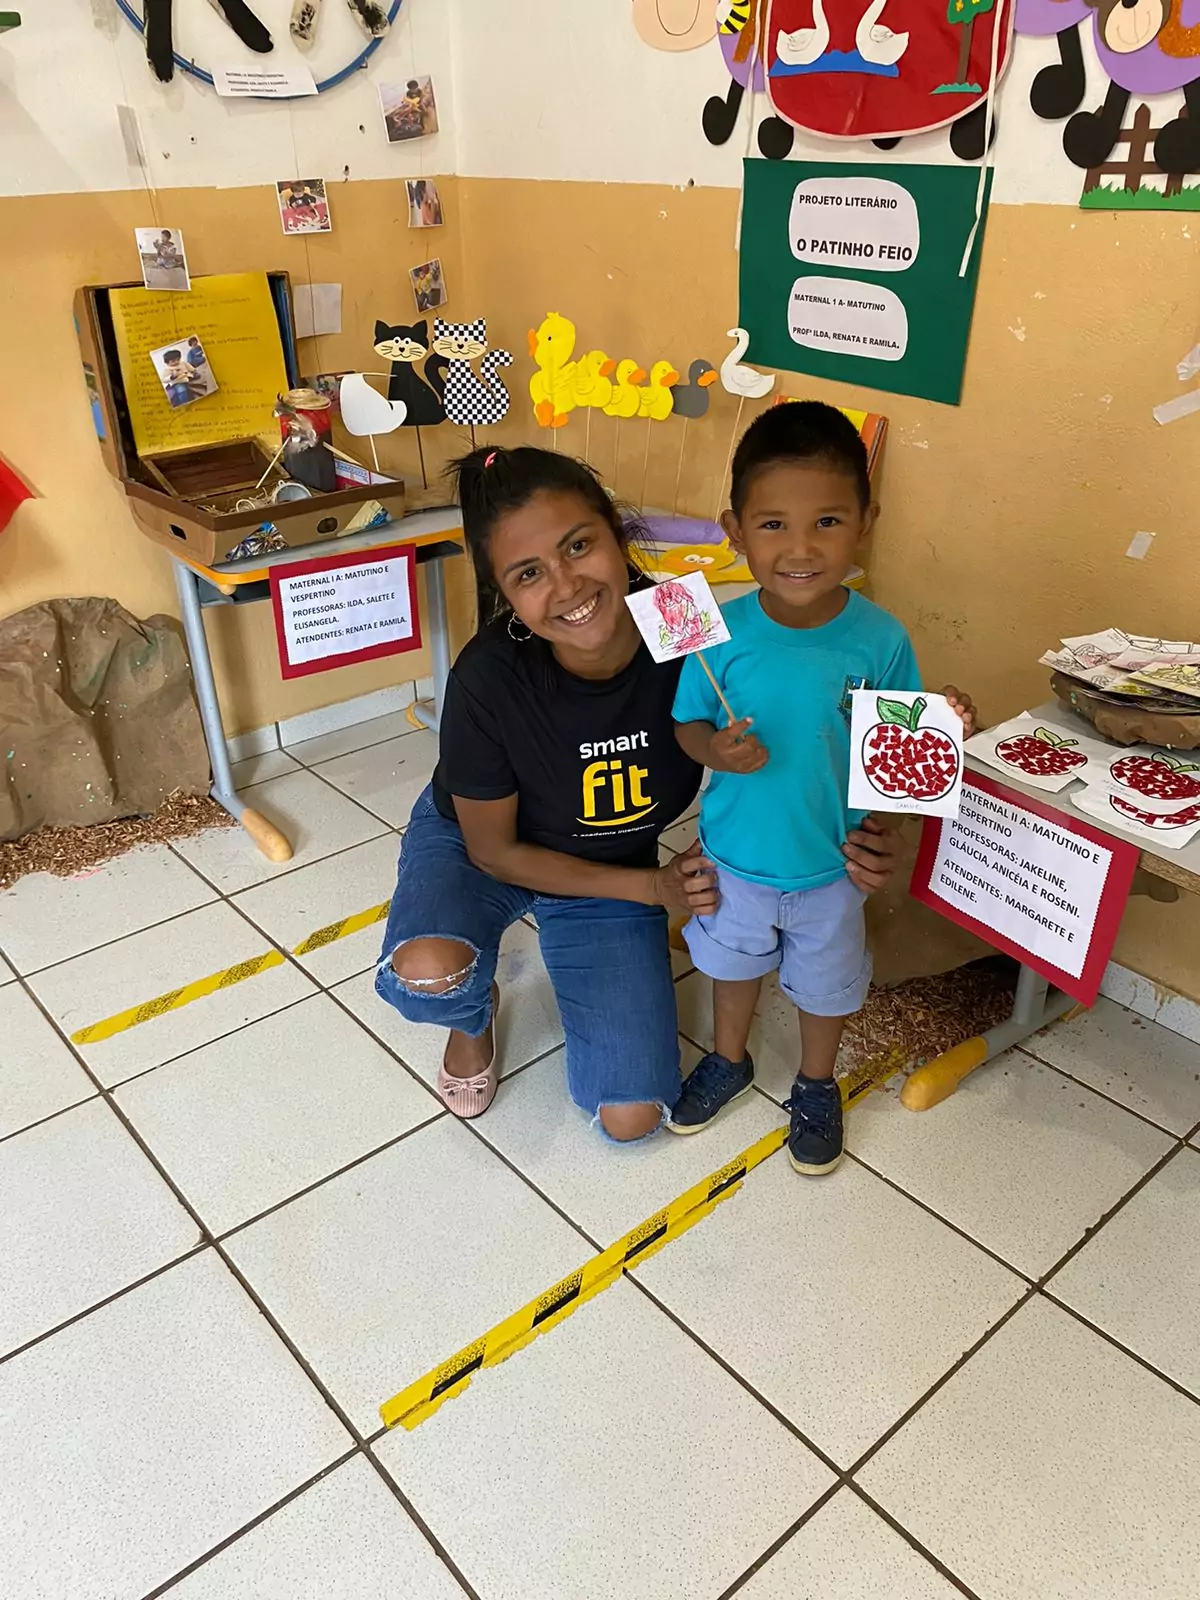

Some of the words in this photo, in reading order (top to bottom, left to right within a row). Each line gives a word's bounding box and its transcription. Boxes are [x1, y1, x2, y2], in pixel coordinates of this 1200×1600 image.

[799, 194, 842, 207] PROJETO
[845, 196, 897, 209] LITERÁRIO
[797, 239, 806, 252] O
[811, 239, 874, 258] PATINHO
[878, 245, 913, 261] FEIO
[794, 294, 830, 306] MATERNAL
[847, 301, 886, 312] MATUTINO
[813, 330, 831, 340] ILDA,
[832, 333, 861, 344] RENATA
[869, 337, 900, 349] RAMILA.
[290, 576, 330, 590] MATERNAL
[336, 574, 343, 582] A:
[344, 566, 384, 580] MATUTINO
[291, 588, 336, 603] VESPERTINO
[293, 602, 346, 618] PROFESSORAS:
[347, 598, 365, 608] ILDA,
[366, 593, 390, 604] SALETE
[296, 630, 344, 645] ATENDENTES:
[346, 624, 372, 635] RENATA
[380, 617, 407, 628] RAMILA.
[580, 730, 649, 759] smart
[583, 760, 651, 818] fit
[960, 804, 1012, 837] ESPERTINO
[1011, 813, 1017, 822] II
[1020, 816, 1029, 829] A:
[1032, 822, 1090, 859] MATUTINO
[1093, 853, 1100, 864] E
[952, 821, 1018, 864] PROFESSORAS:
[1019, 860, 1068, 892] JAKELINE,
[940, 874, 978, 903] EDILENE.
[949, 836, 990, 868] GLÁUCIA,
[992, 862, 1029, 889] ANICÉIA
[1032, 882, 1038, 893] E
[1040, 886, 1080, 918] ROSENI.
[944, 859, 1003, 900] ATENDENTES:
[1005, 894, 1067, 937] MARGARETE
[1068, 932, 1075, 943] E
